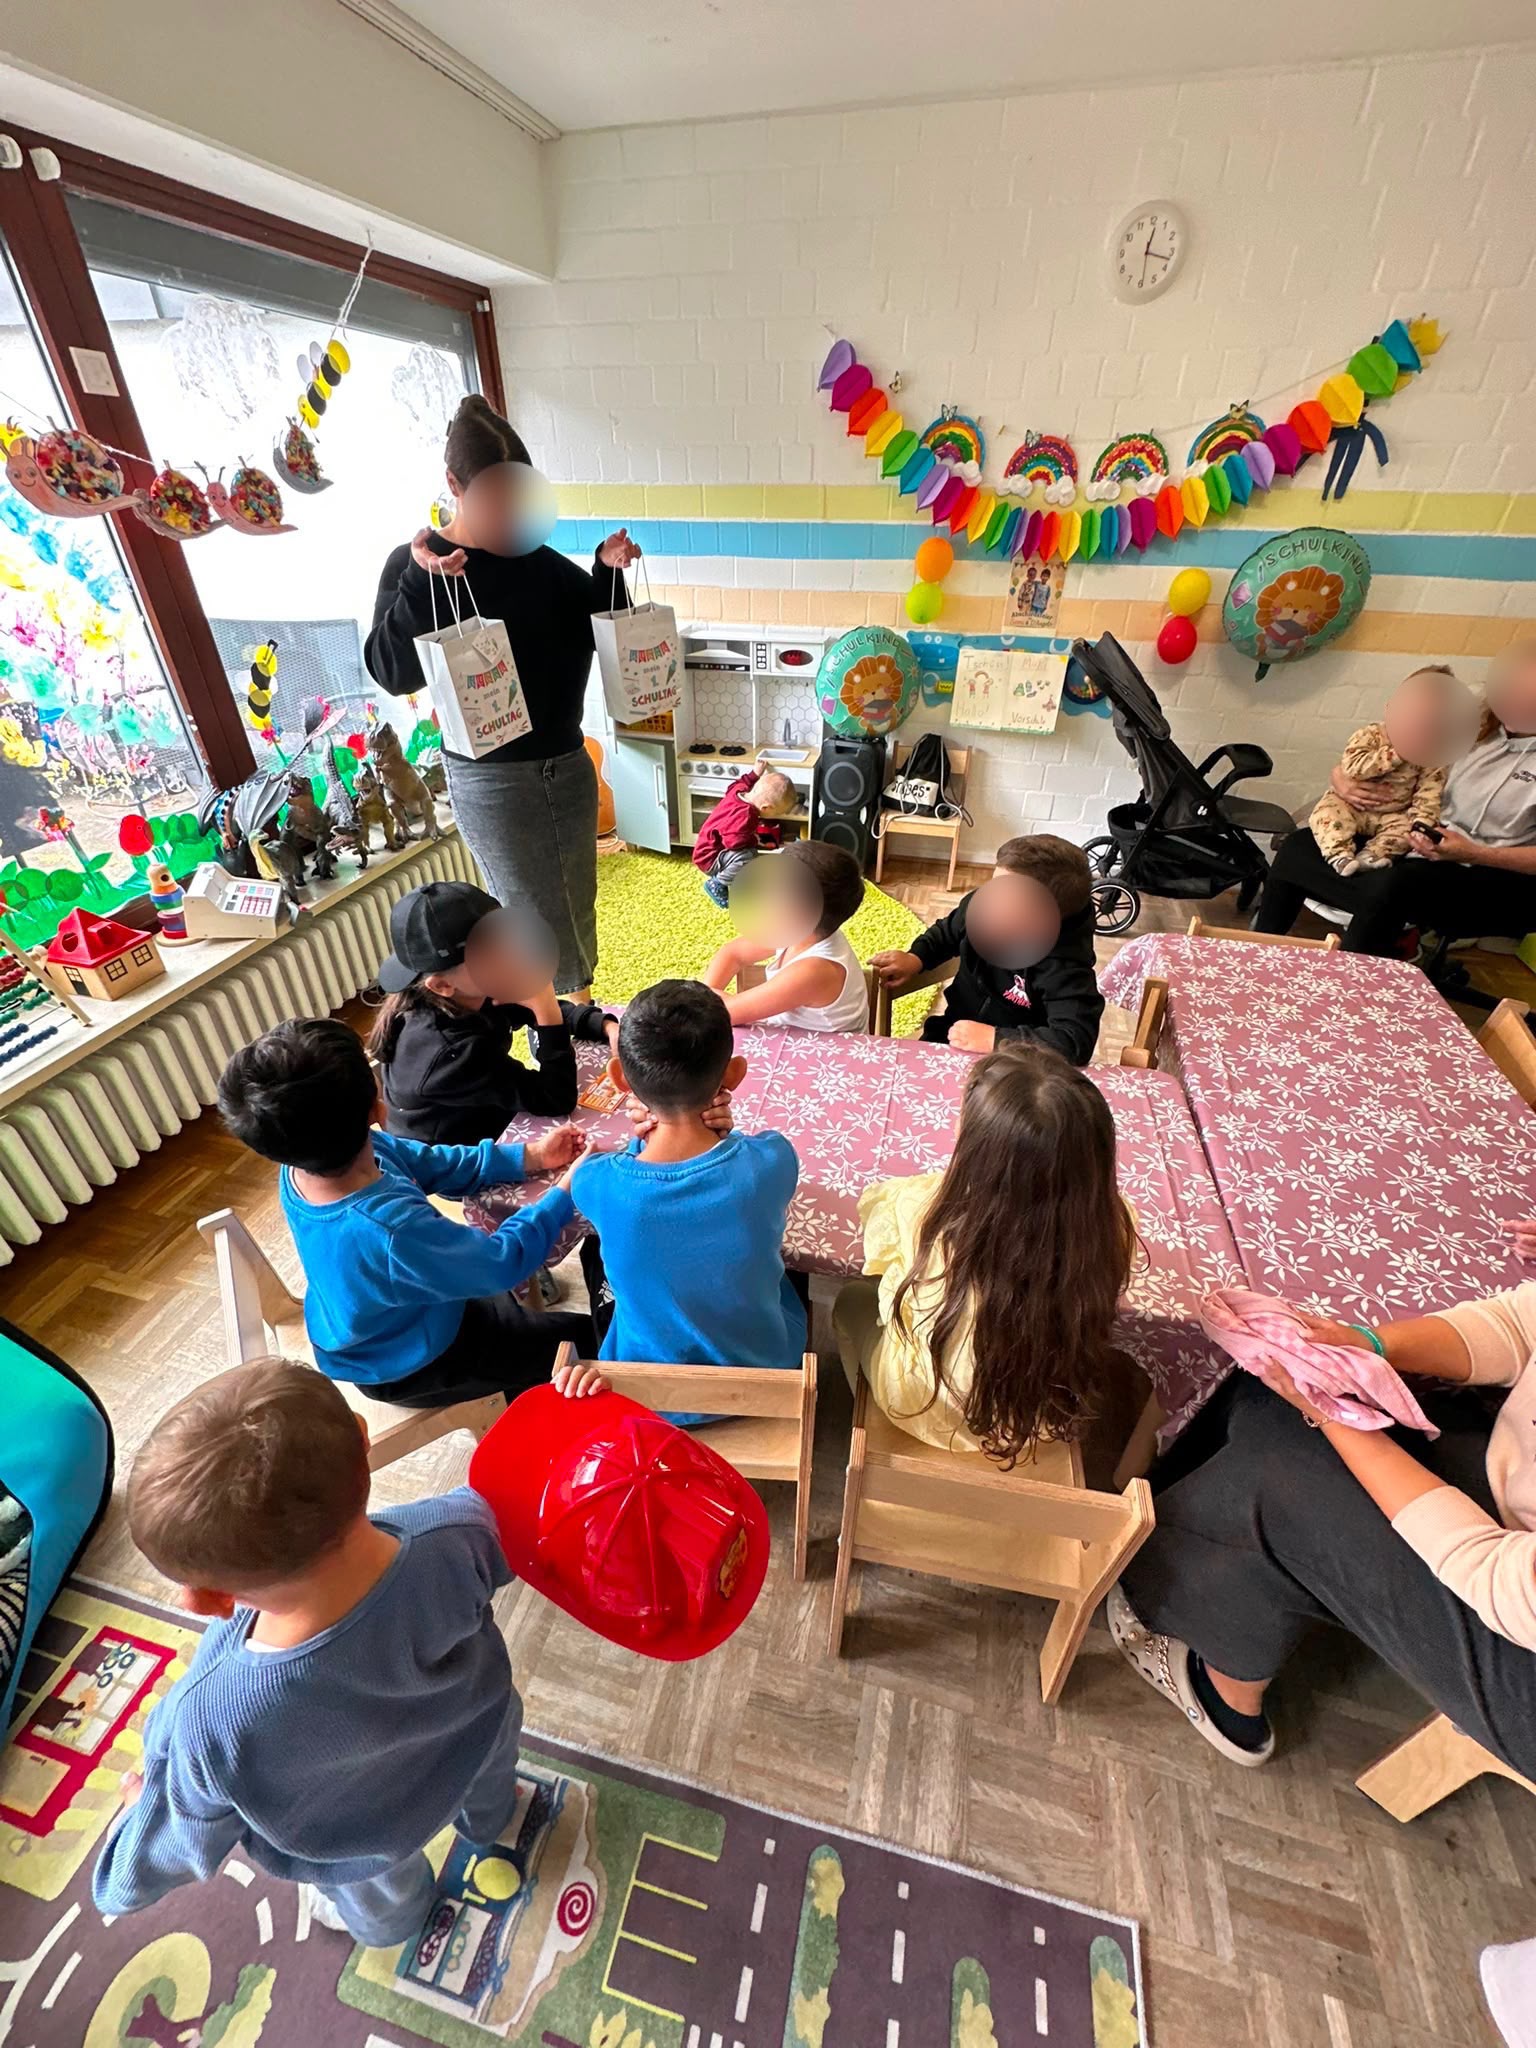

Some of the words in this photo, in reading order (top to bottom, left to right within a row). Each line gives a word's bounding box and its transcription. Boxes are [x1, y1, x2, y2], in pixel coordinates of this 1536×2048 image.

[1150, 216, 1158, 225] 12
[1163, 220, 1168, 230] 1
[1137, 222, 1144, 230] 11
[1126, 233, 1133, 242] 10
[1169, 232, 1176, 241] 2
[1119, 249, 1125, 258] 9
[1169, 247, 1175, 257] 3
[1119, 264, 1126, 274] 8
[1162, 264, 1168, 272] 4
[1127, 275, 1133, 284] 7
[1137, 279, 1143, 288] 6
[1151, 274, 1157, 284] 5
[1265, 538, 1364, 576] SCHULKIND
[827, 632, 901, 674] CHULKIND
[643, 665, 660, 673] mein
[483, 688, 500, 700] mein
[631, 686, 677, 707] SCHULTAG
[475, 708, 523, 739] SCHULTAG
